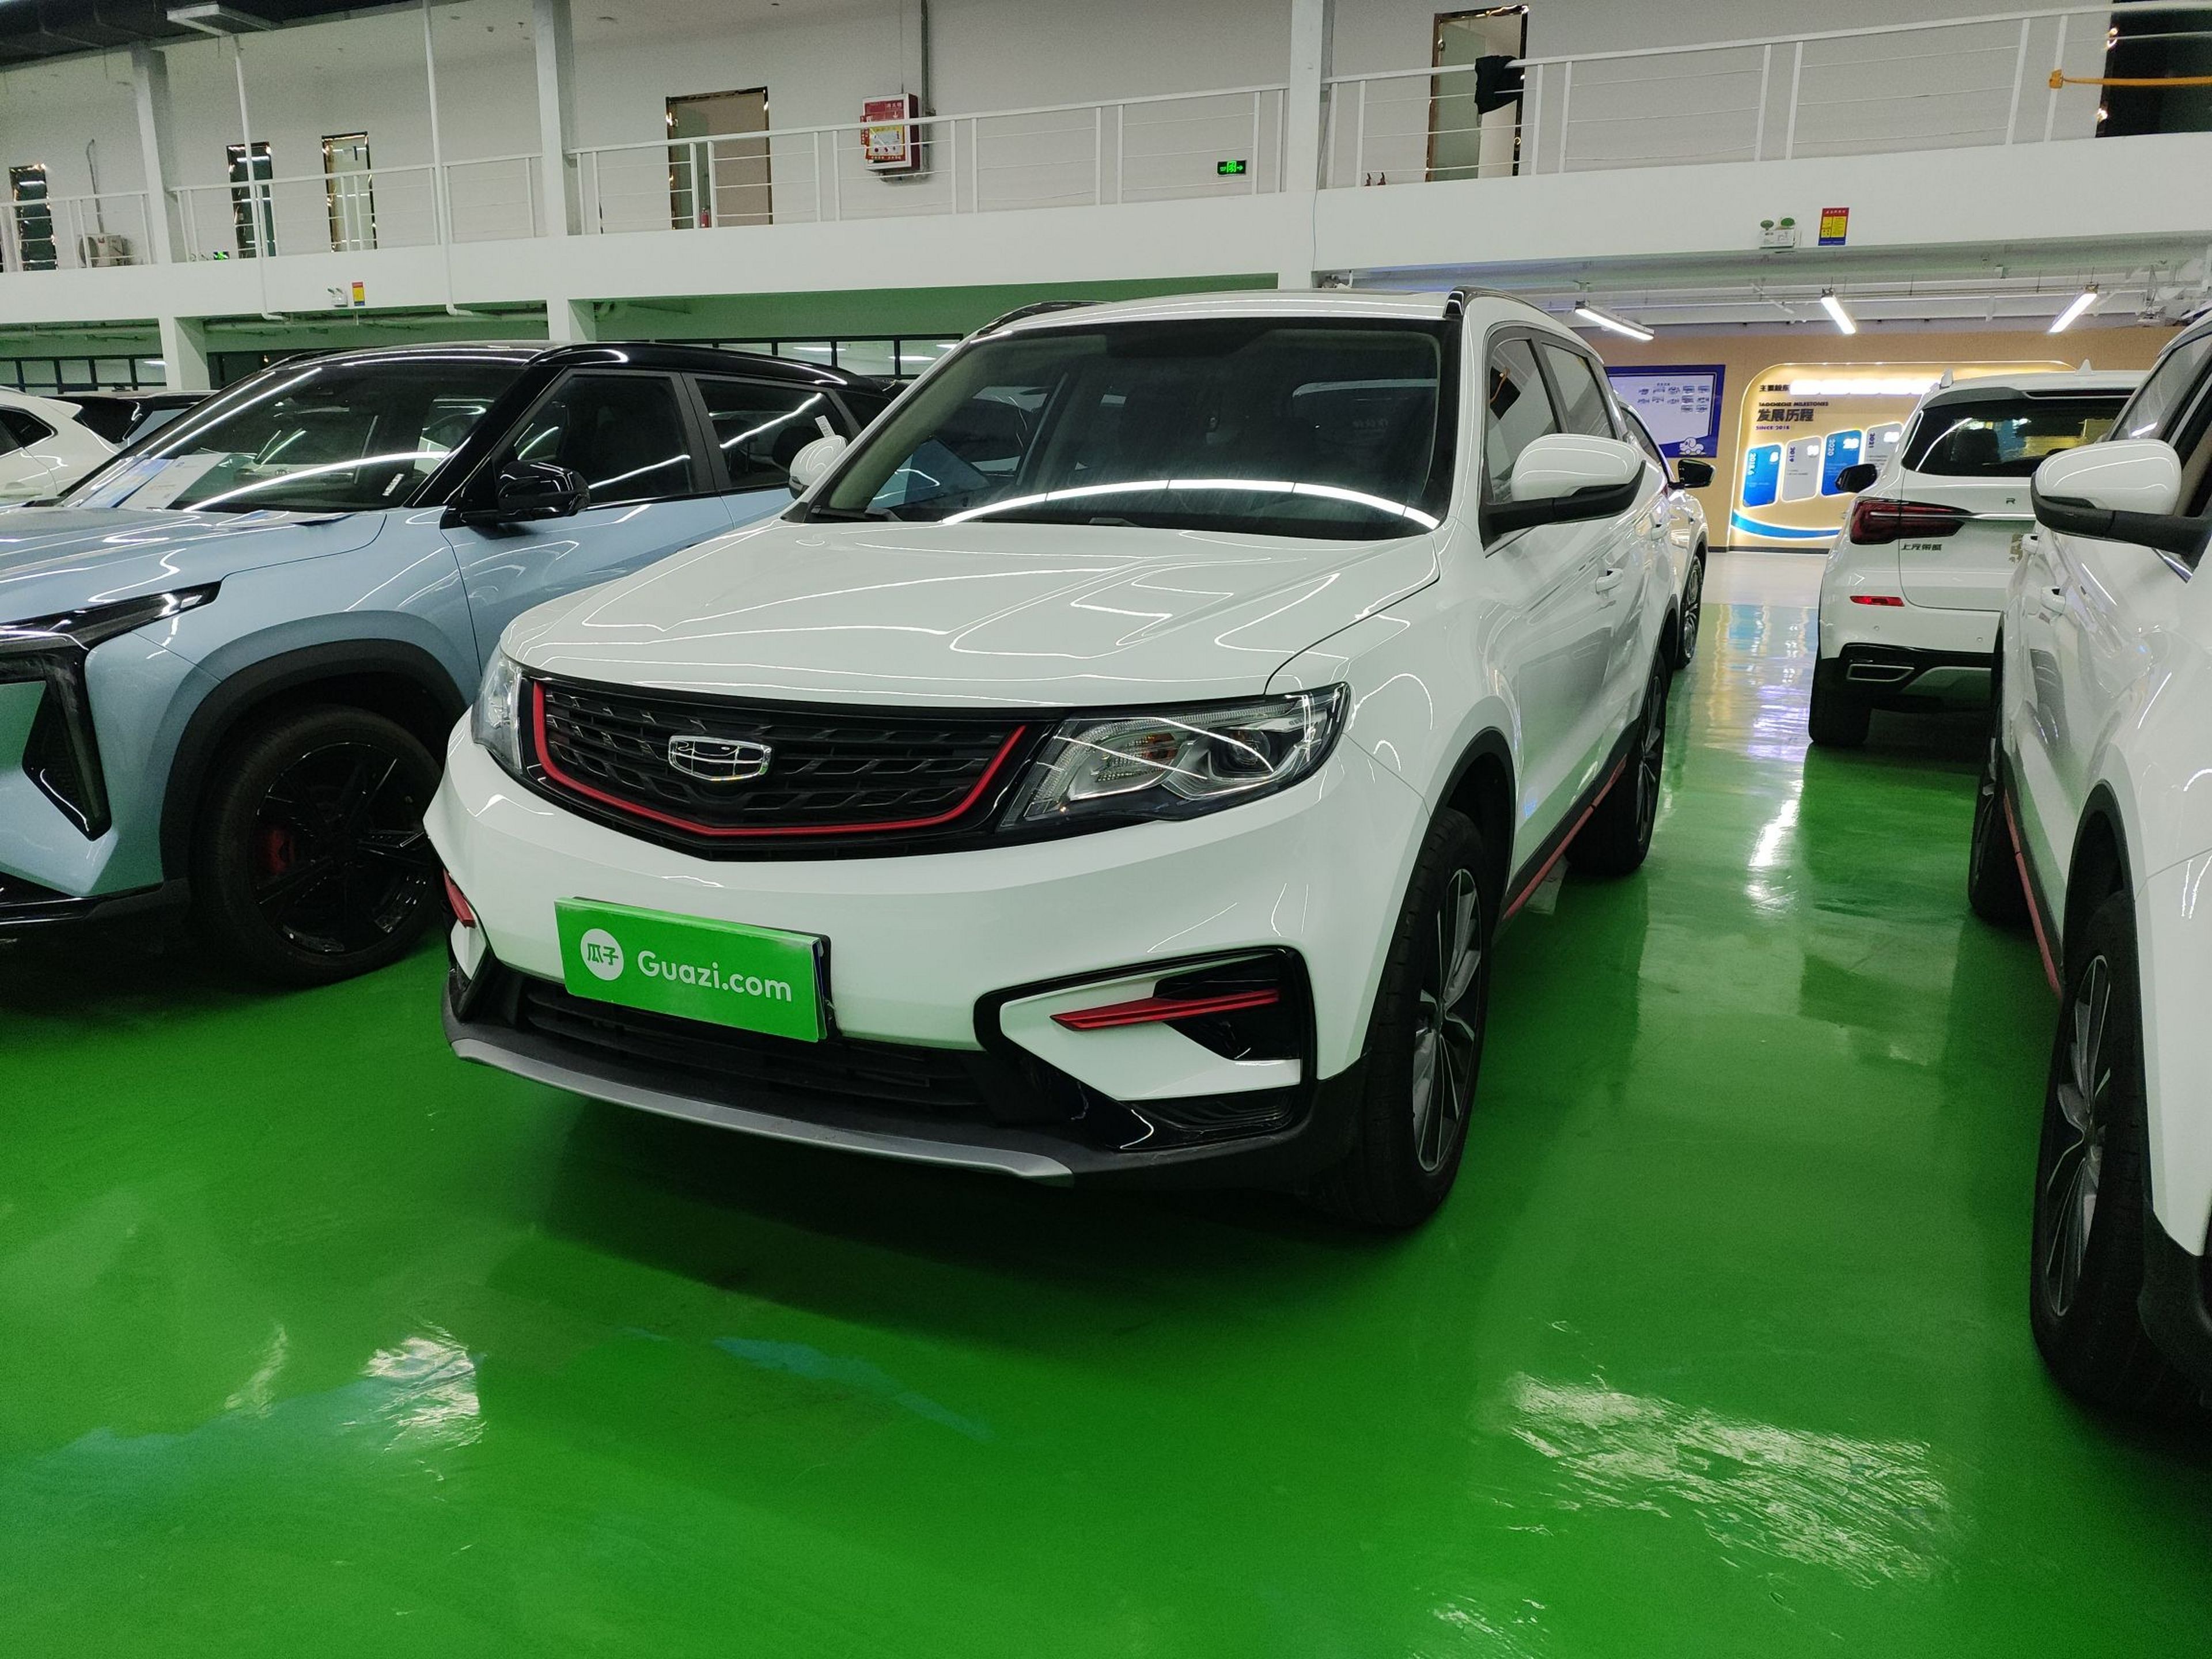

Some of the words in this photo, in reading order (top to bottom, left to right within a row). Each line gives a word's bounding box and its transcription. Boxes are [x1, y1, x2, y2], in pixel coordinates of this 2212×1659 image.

[1757, 408, 1814, 422] 发展历程
[1827, 438, 1836, 456] 2020
[587, 943, 619, 965] 瓜子
[638, 950, 791, 1002] Guazi.com
